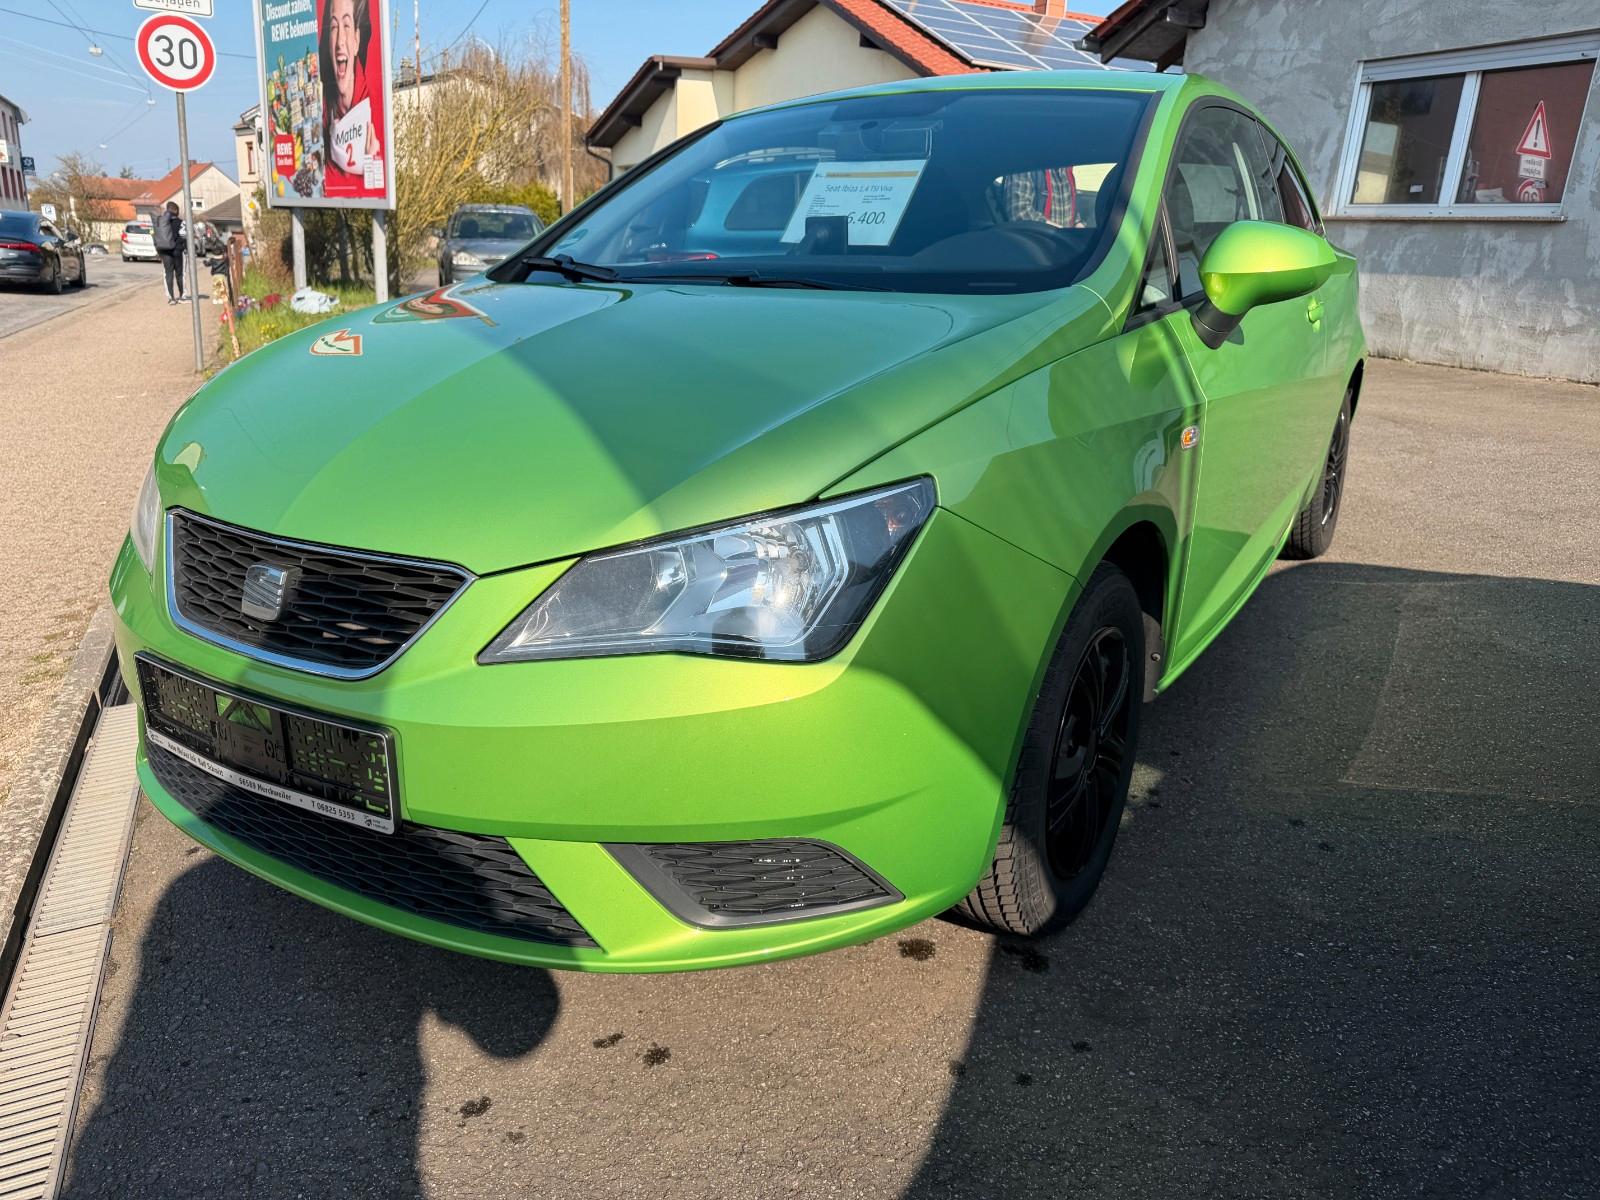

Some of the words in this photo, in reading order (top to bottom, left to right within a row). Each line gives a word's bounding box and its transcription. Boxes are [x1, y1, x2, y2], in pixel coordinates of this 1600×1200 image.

[266, 0, 291, 21] Discount
[271, 21, 290, 42] REWE
[154, 34, 198, 70] 30
[336, 124, 363, 145] Mathe
[276, 142, 293, 156] REWE
[345, 143, 356, 167] 2
[824, 184, 841, 193] Seat
[311, 800, 316, 808] T
[316, 801, 337, 815] 06825
[338, 808, 355, 820] 5353
